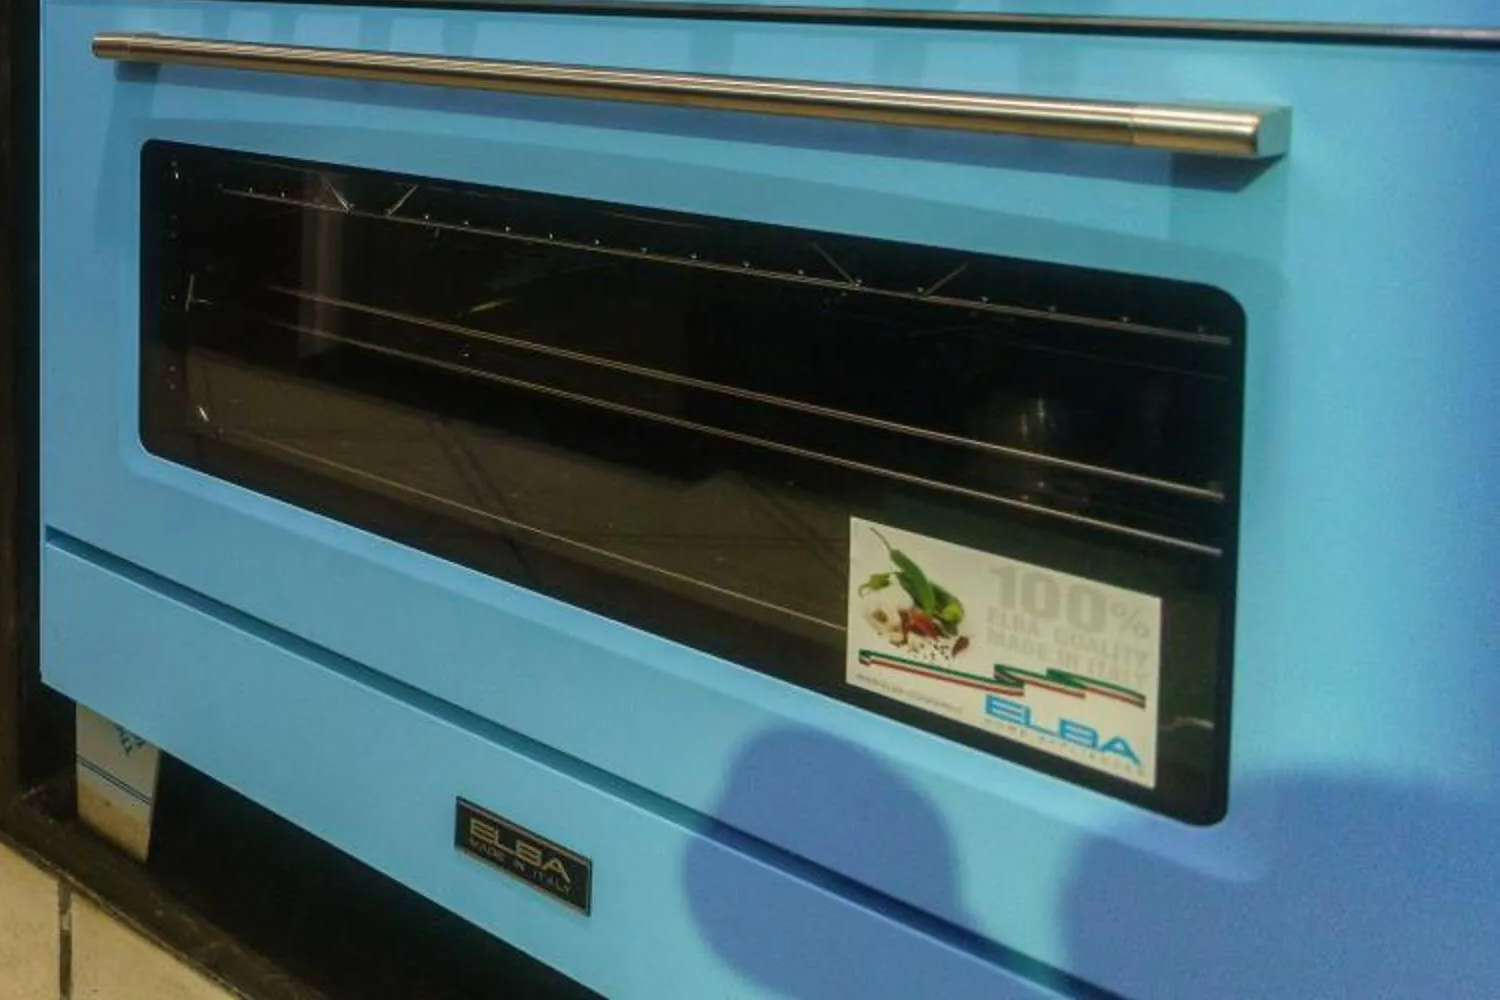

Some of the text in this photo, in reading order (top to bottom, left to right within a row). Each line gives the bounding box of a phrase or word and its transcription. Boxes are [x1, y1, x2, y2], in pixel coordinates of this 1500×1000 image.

[989, 565, 1150, 639] 100%
[984, 694, 1143, 768] ELBA
[469, 817, 571, 884] ELBA
